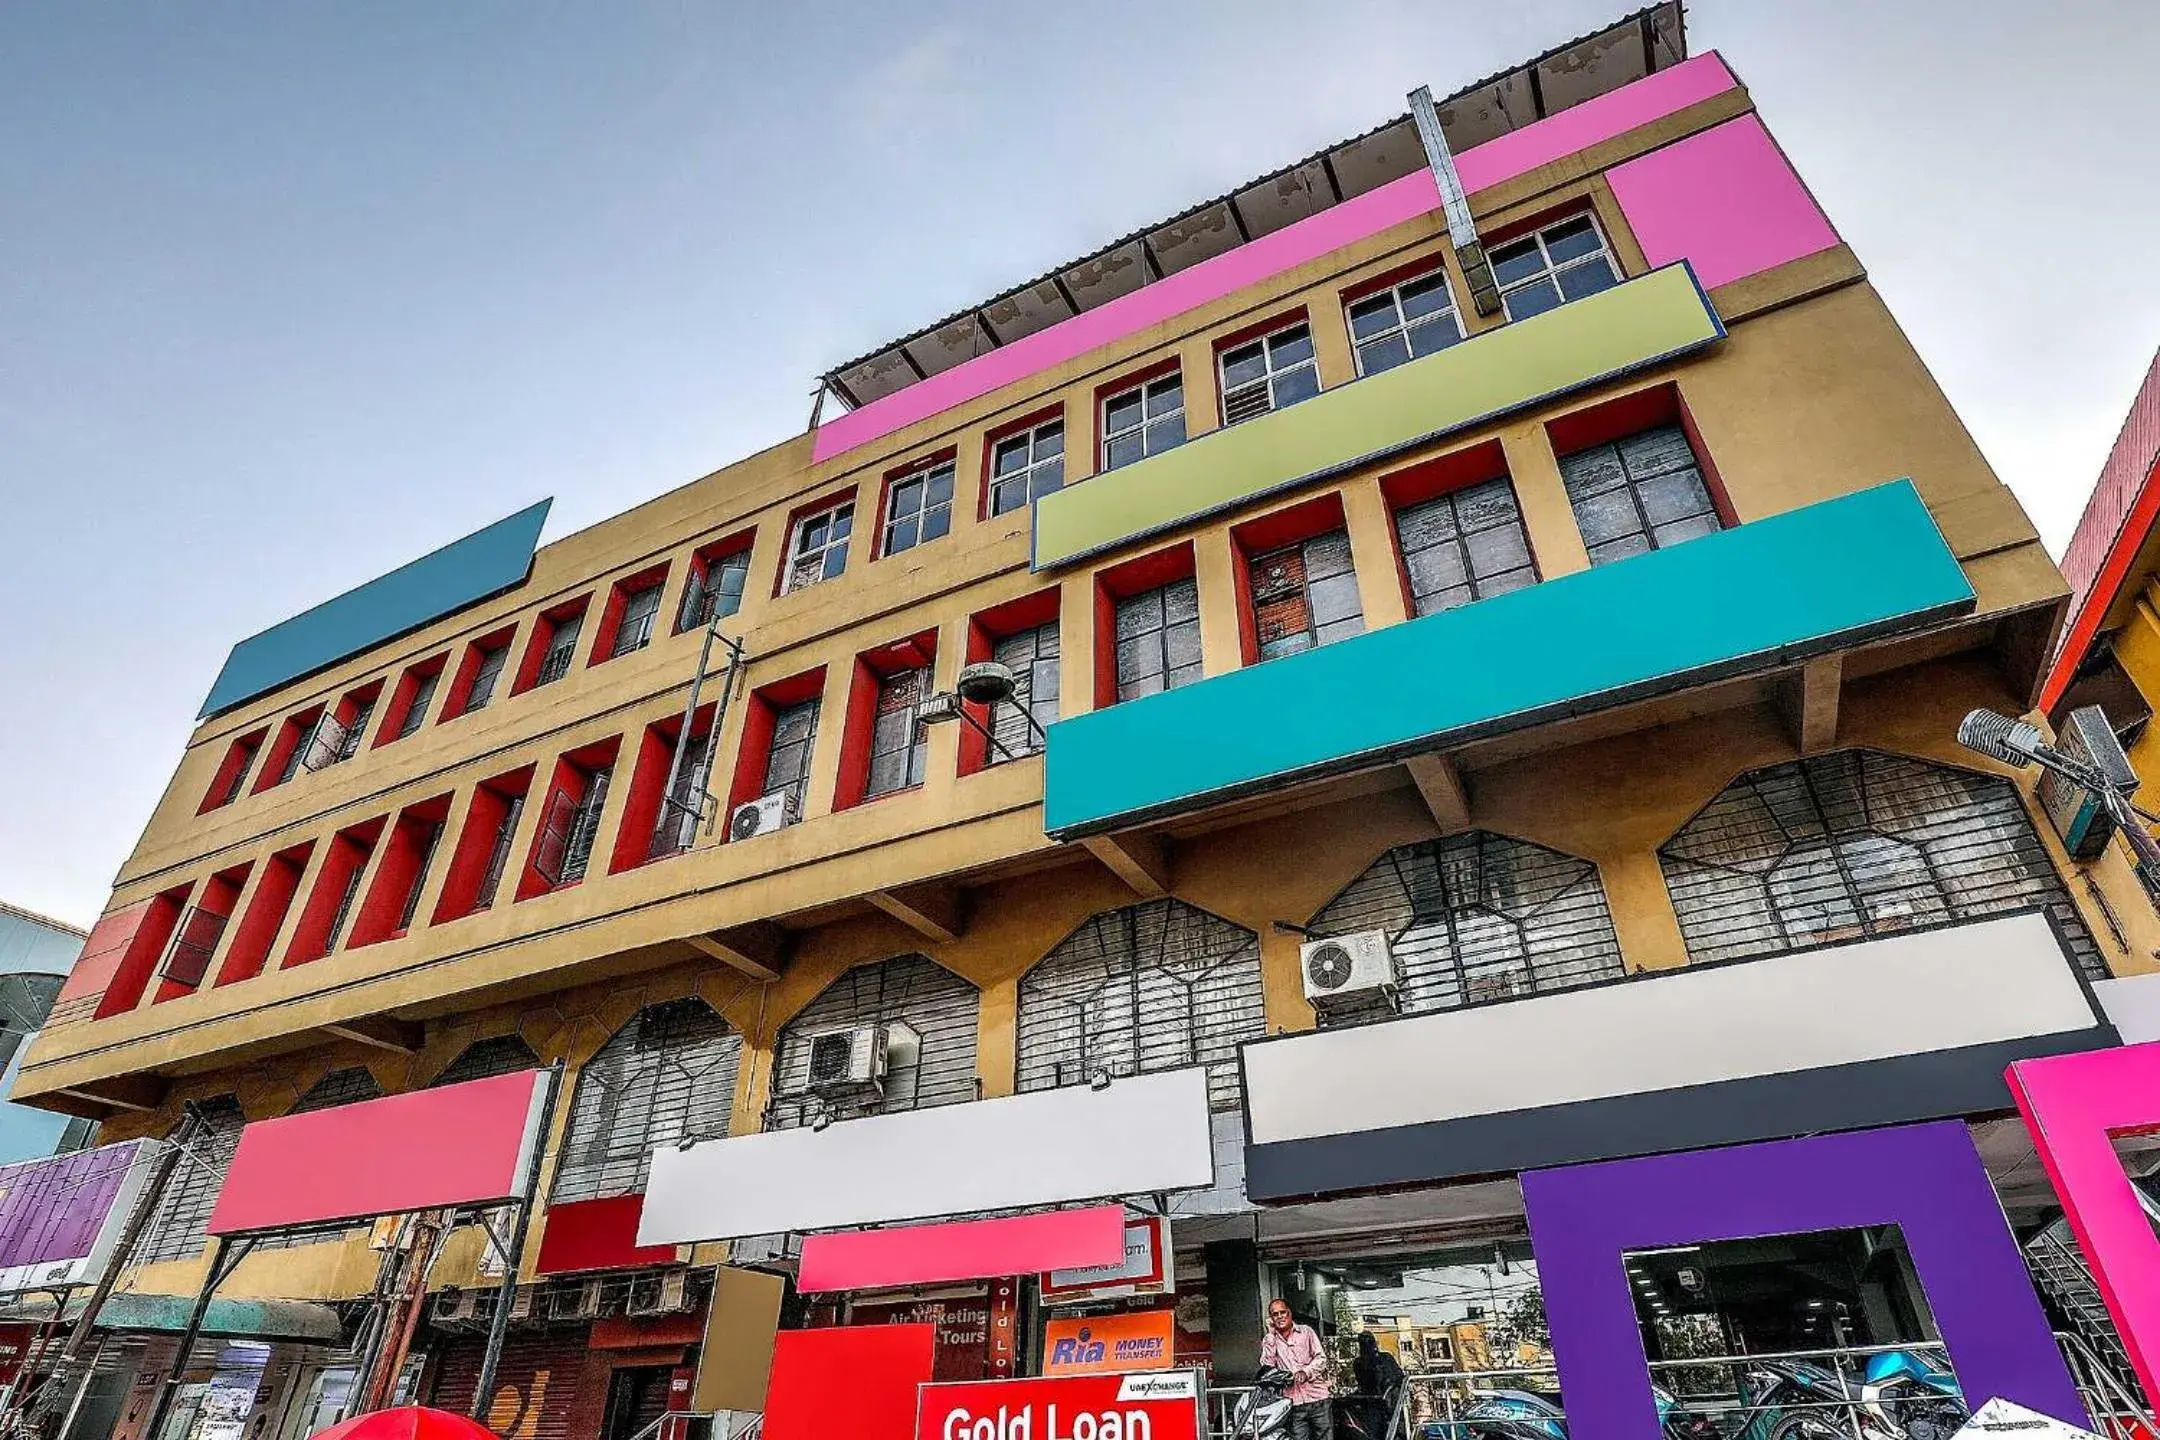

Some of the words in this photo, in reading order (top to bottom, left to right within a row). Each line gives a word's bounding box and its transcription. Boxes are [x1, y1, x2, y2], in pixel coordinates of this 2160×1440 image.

[940, 1329, 986, 1345] Tours
[1051, 1327, 1106, 1365] Ria
[1115, 1337, 1164, 1351] MONEY
[996, 1340, 1007, 1379] Lo
[1114, 1350, 1163, 1361] TRANSFER
[943, 1404, 1033, 1440] Gold
[1047, 1403, 1151, 1440] Loan
